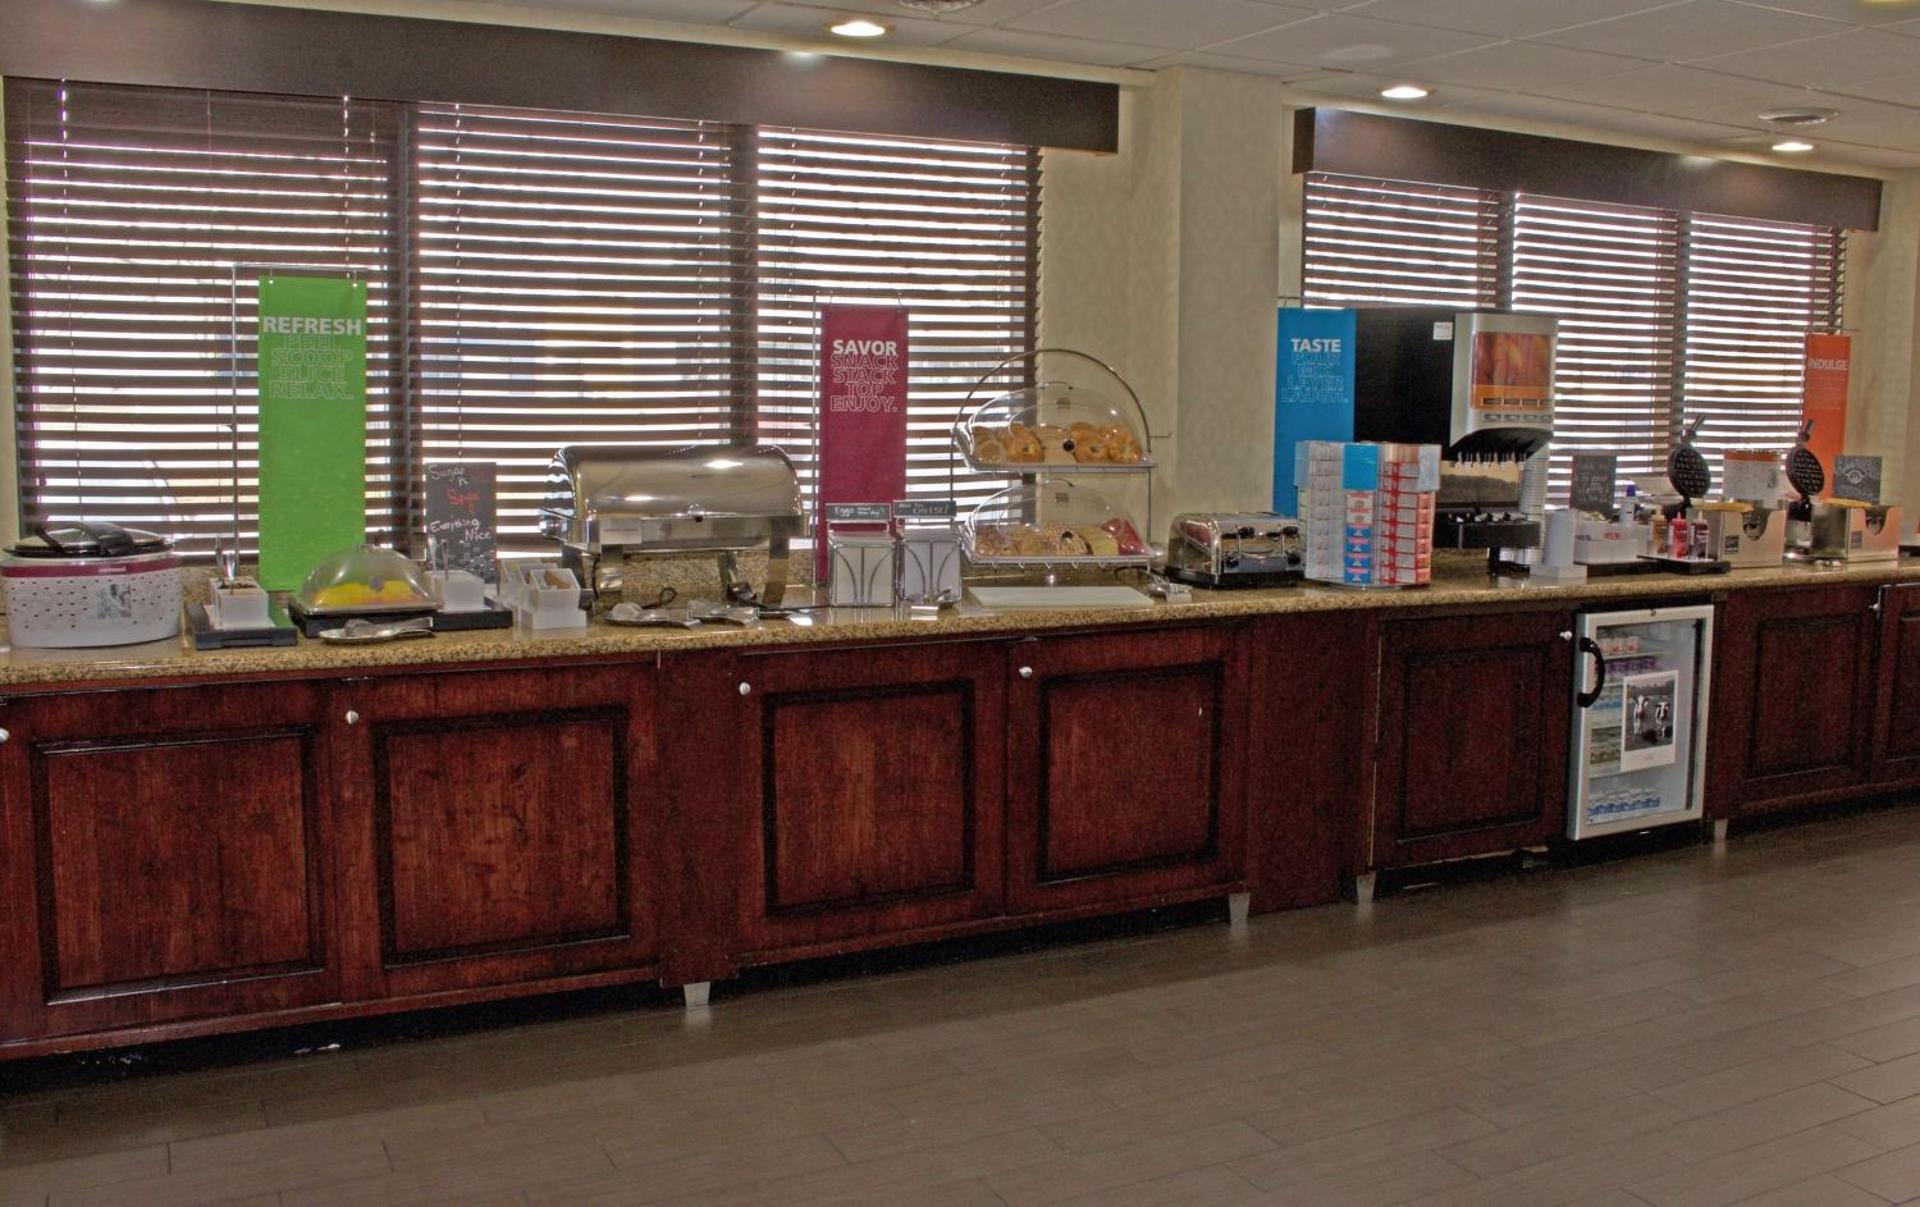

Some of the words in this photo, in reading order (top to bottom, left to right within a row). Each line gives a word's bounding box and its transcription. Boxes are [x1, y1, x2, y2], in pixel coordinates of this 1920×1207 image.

[263, 316, 362, 335] REFRESH
[832, 339, 898, 356] SAVOR
[1290, 338, 1342, 353] TASTE
[271, 348, 354, 367] SCOOP
[831, 354, 899, 370] SNACK
[1808, 358, 1848, 371] INDULGE
[279, 365, 345, 383] SLICE
[832, 367, 897, 385] STACK
[846, 382, 884, 397] TOP
[830, 395, 898, 413] ENJOY.
[465, 528, 492, 541] Nice
